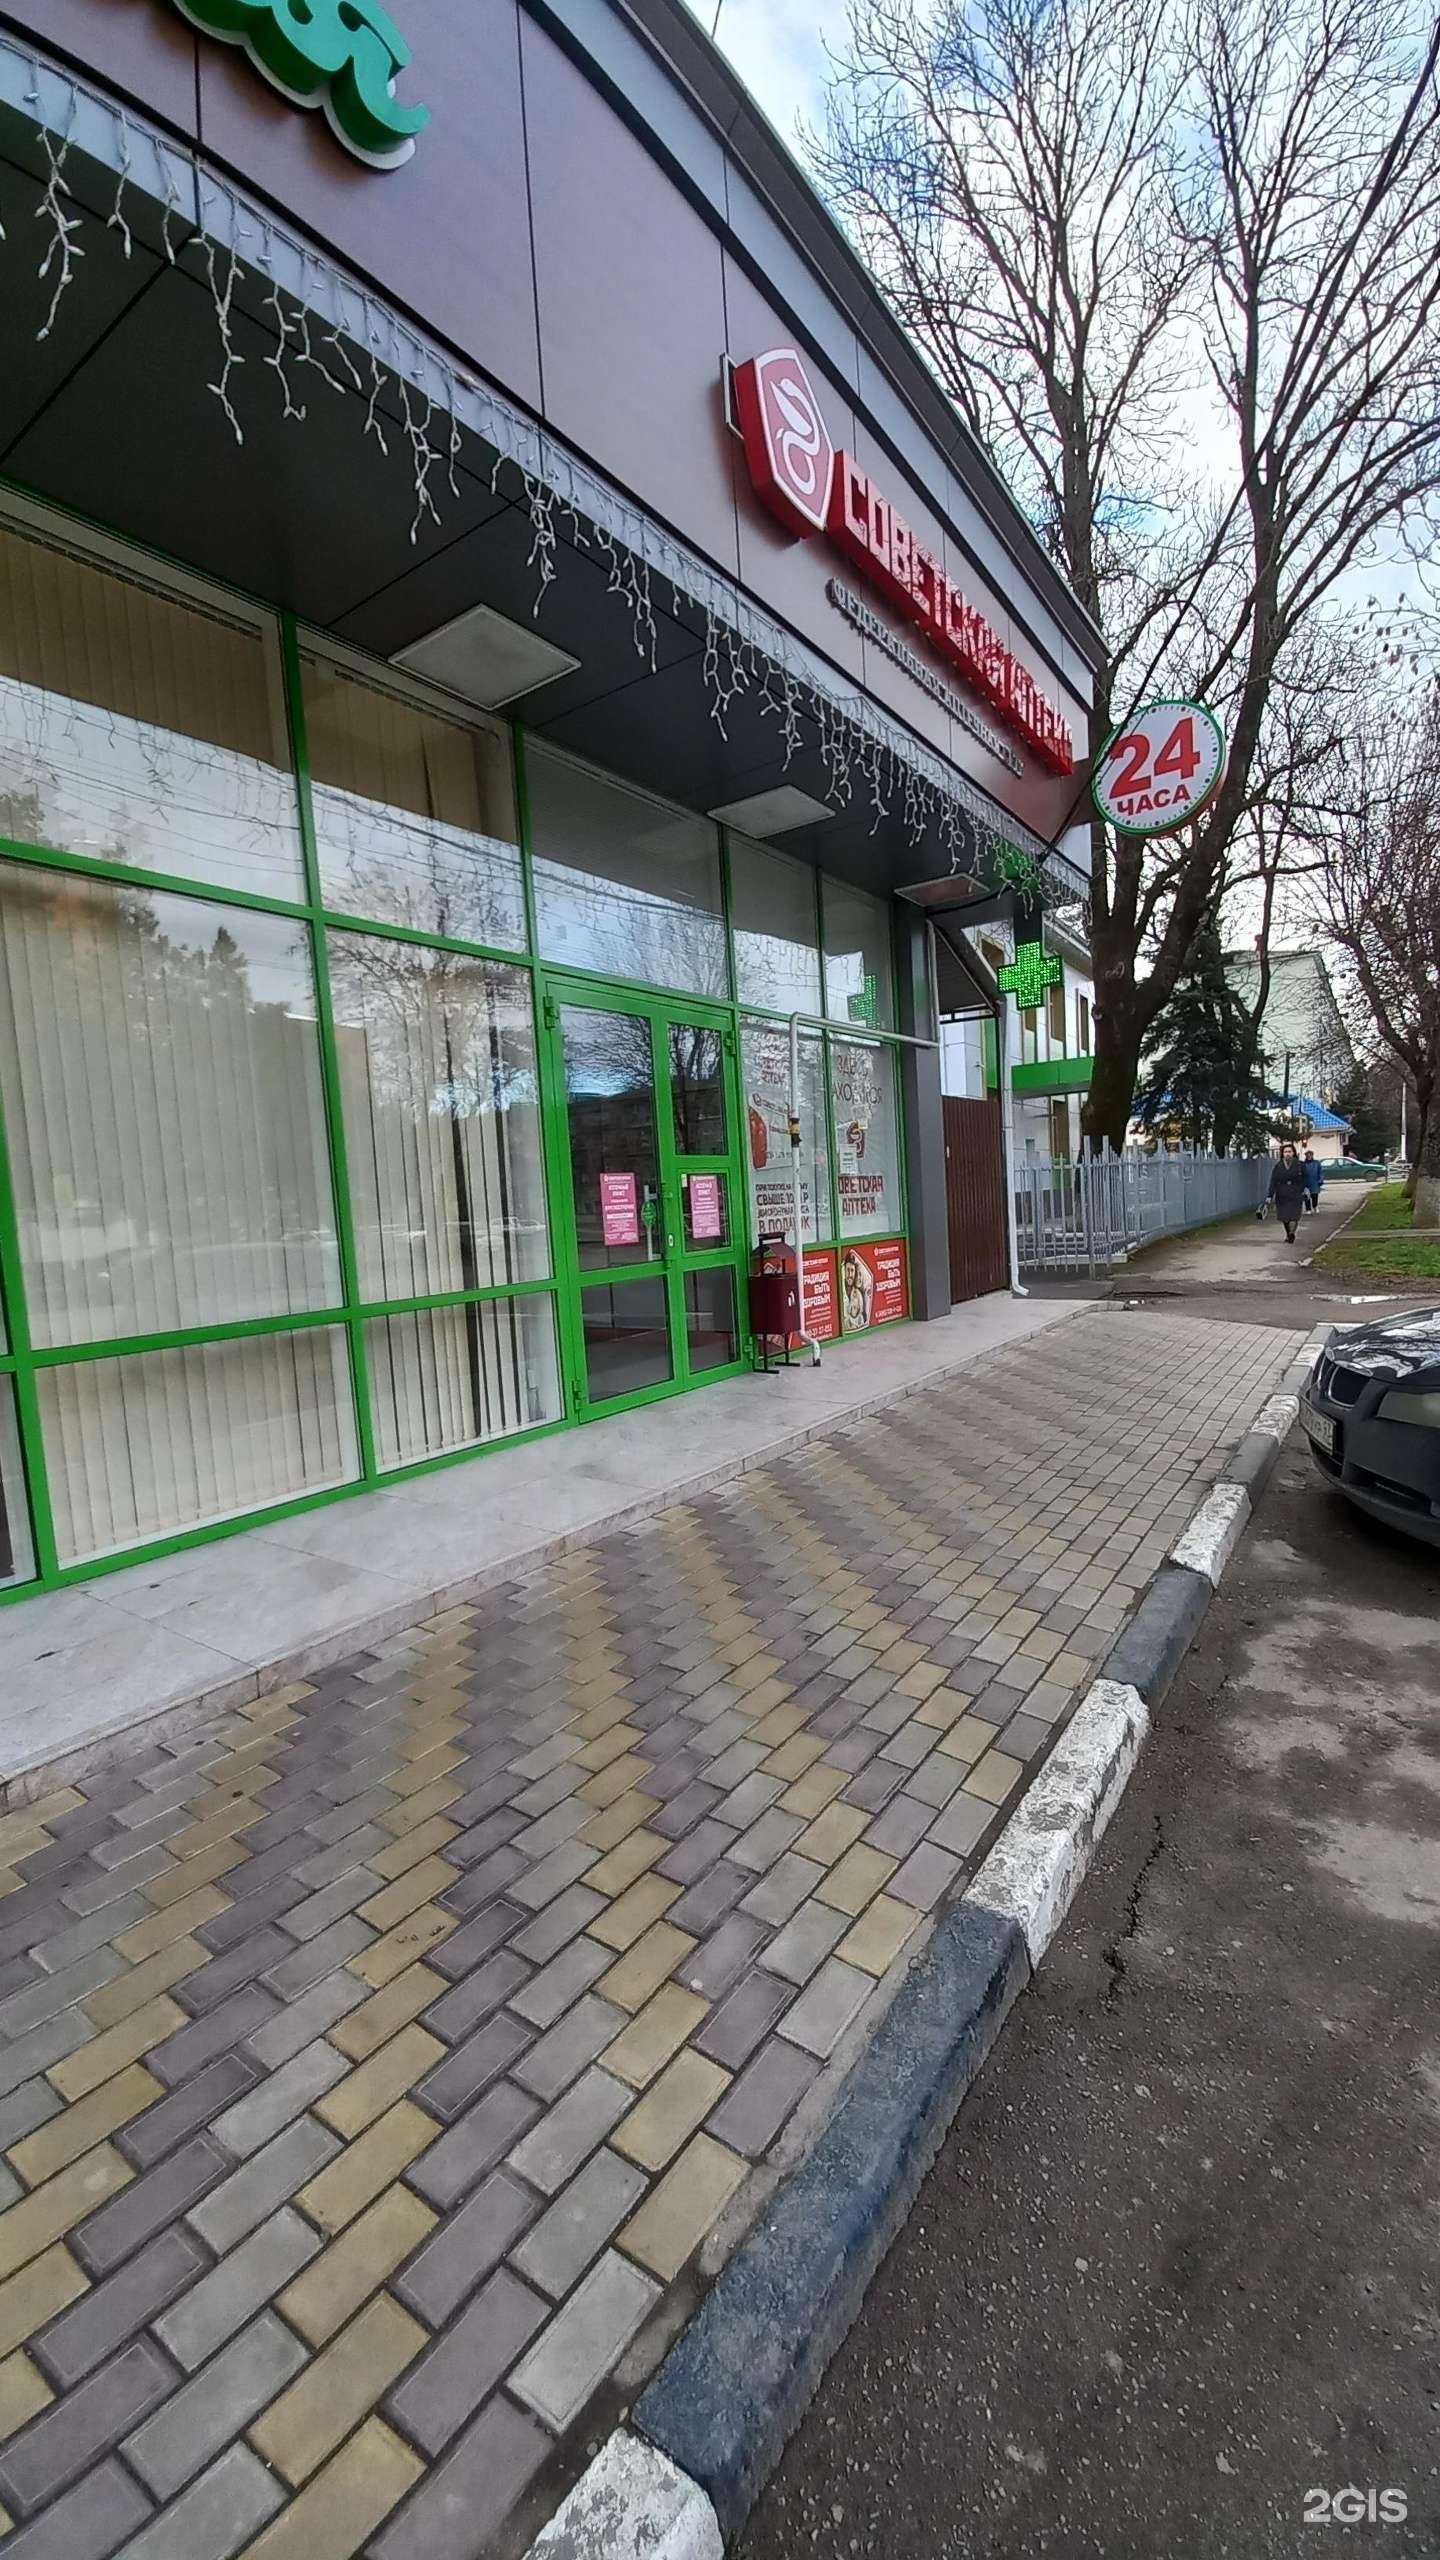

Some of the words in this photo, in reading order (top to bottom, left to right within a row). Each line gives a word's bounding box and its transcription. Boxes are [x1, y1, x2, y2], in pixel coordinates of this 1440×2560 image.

[842, 447, 1006, 698] СОВЕТСКАЯ
[1009, 654, 1074, 770] АПТЕКА
[1109, 716, 1201, 799] 24
[1117, 784, 1191, 816] ЧАСА
[756, 1193, 785, 1205] СВЫШЕ
[842, 1196, 876, 1215] АПТЕКА
